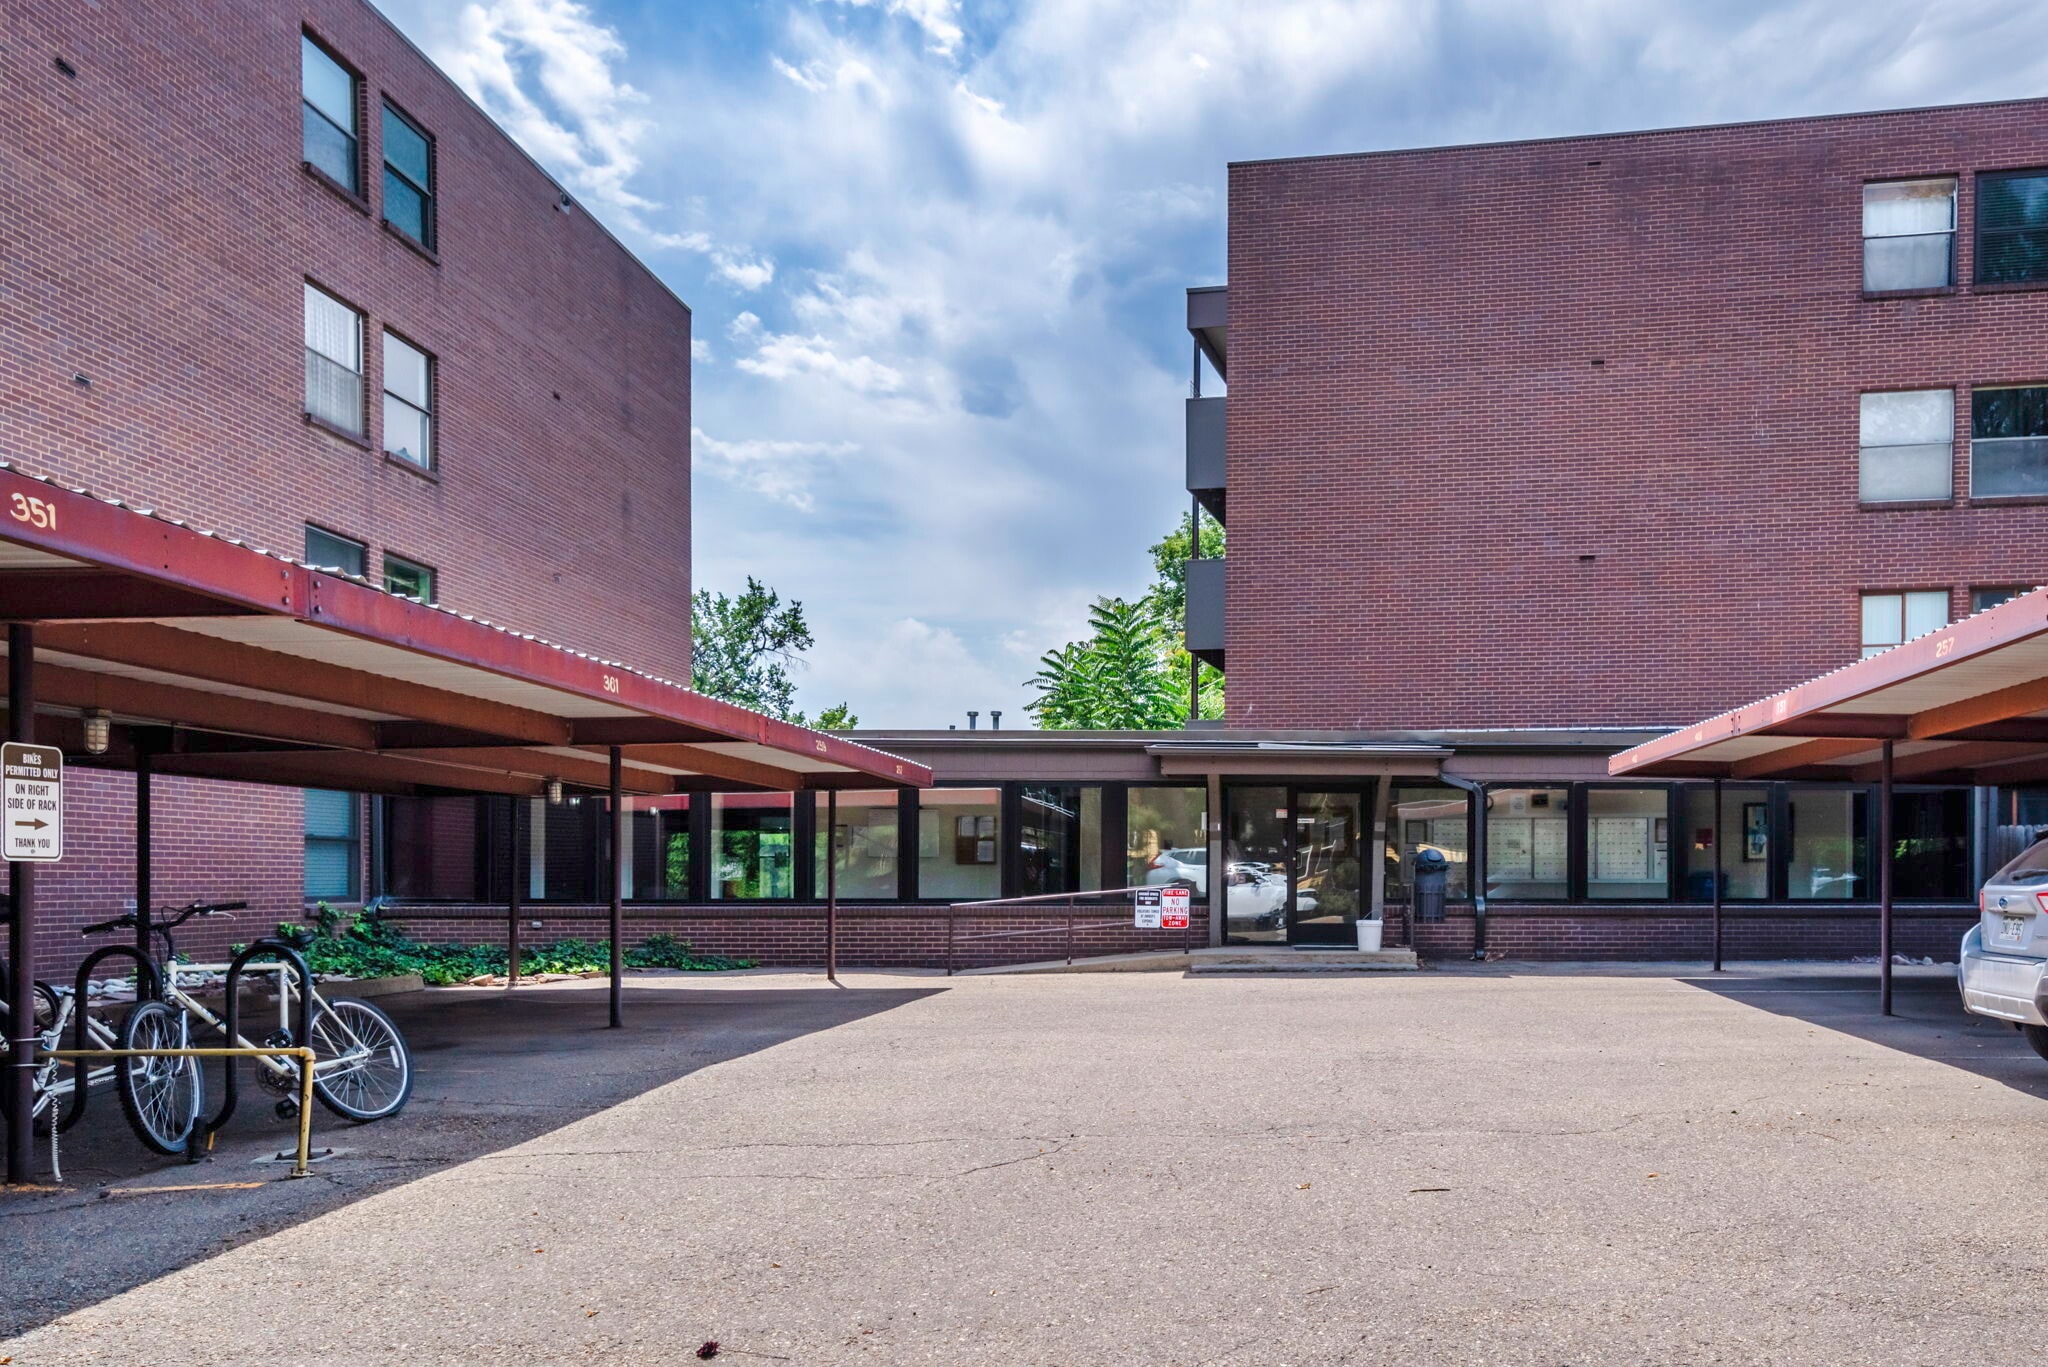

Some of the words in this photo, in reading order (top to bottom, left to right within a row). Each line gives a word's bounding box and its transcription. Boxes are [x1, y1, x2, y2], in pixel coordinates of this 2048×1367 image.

[10, 492, 56, 531] 351
[1936, 637, 1955, 658] 257
[603, 675, 619, 694] 301
[23, 753, 42, 765] BIKES
[5, 765, 41, 777] PERMITTED
[43, 768, 59, 779] ONLY
[15, 783, 26, 794] ON
[28, 784, 50, 796] RIGHT
[8, 798, 24, 810] SIDE
[27, 799, 36, 810] OF
[38, 800, 57, 811] RACK
[15, 838, 36, 848] THANK
[38, 839, 51, 849] YOU
